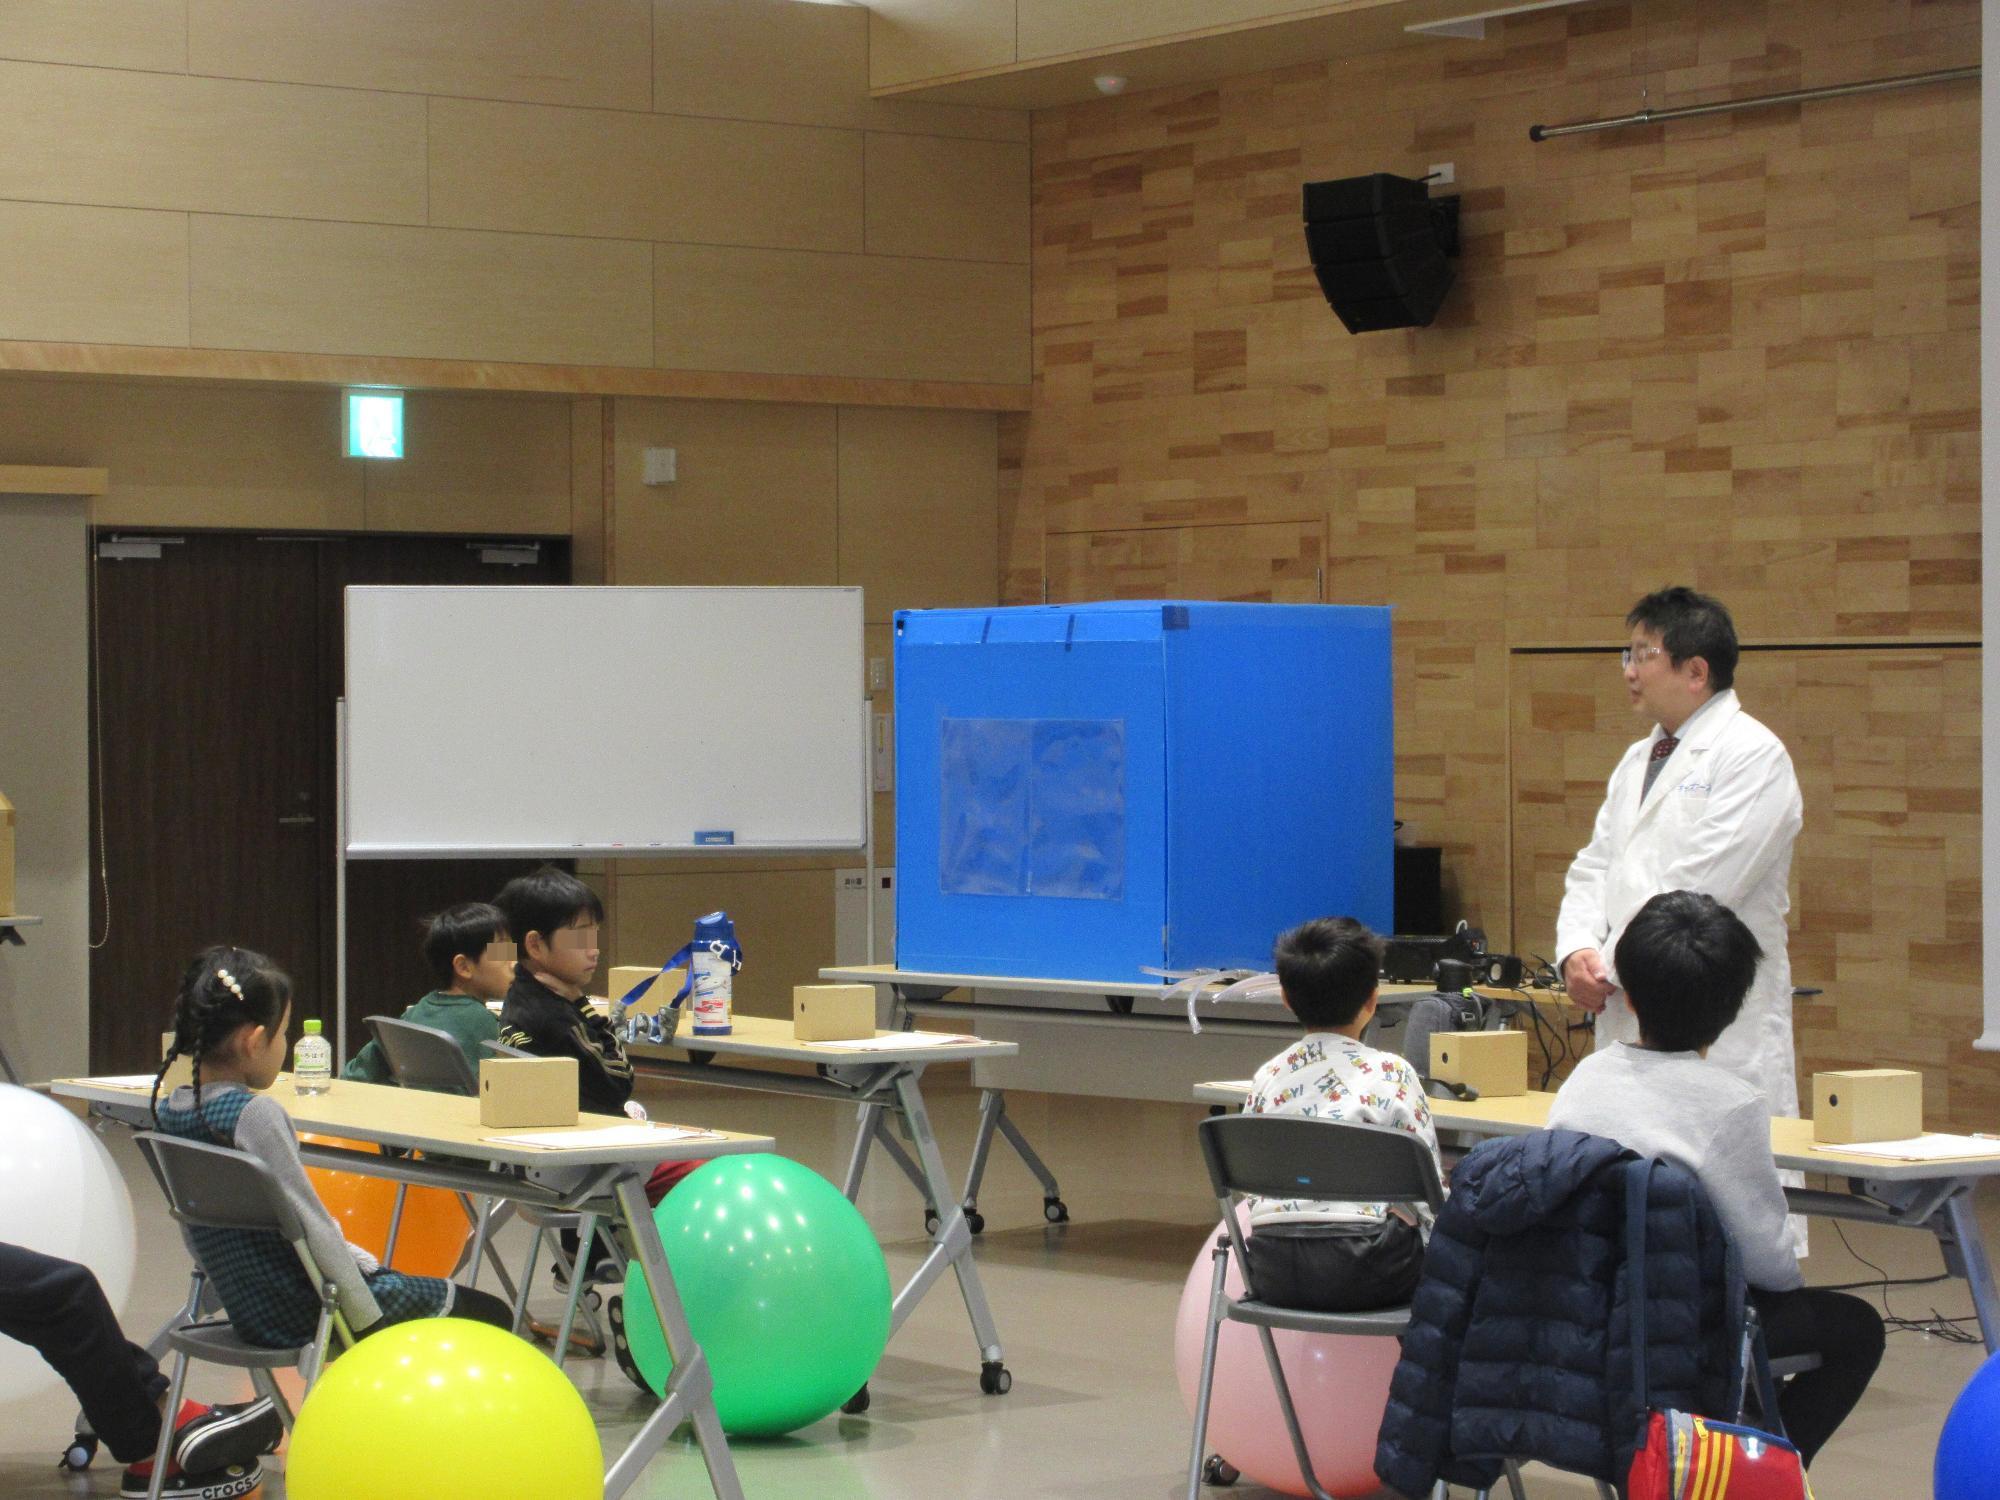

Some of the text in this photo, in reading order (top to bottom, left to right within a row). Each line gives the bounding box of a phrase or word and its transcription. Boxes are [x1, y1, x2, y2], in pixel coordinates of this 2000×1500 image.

[1273, 1084, 1304, 1106] HEY!
[1360, 1093, 1391, 1110] HEY!
[202, 1477, 252, 1499] crocs
